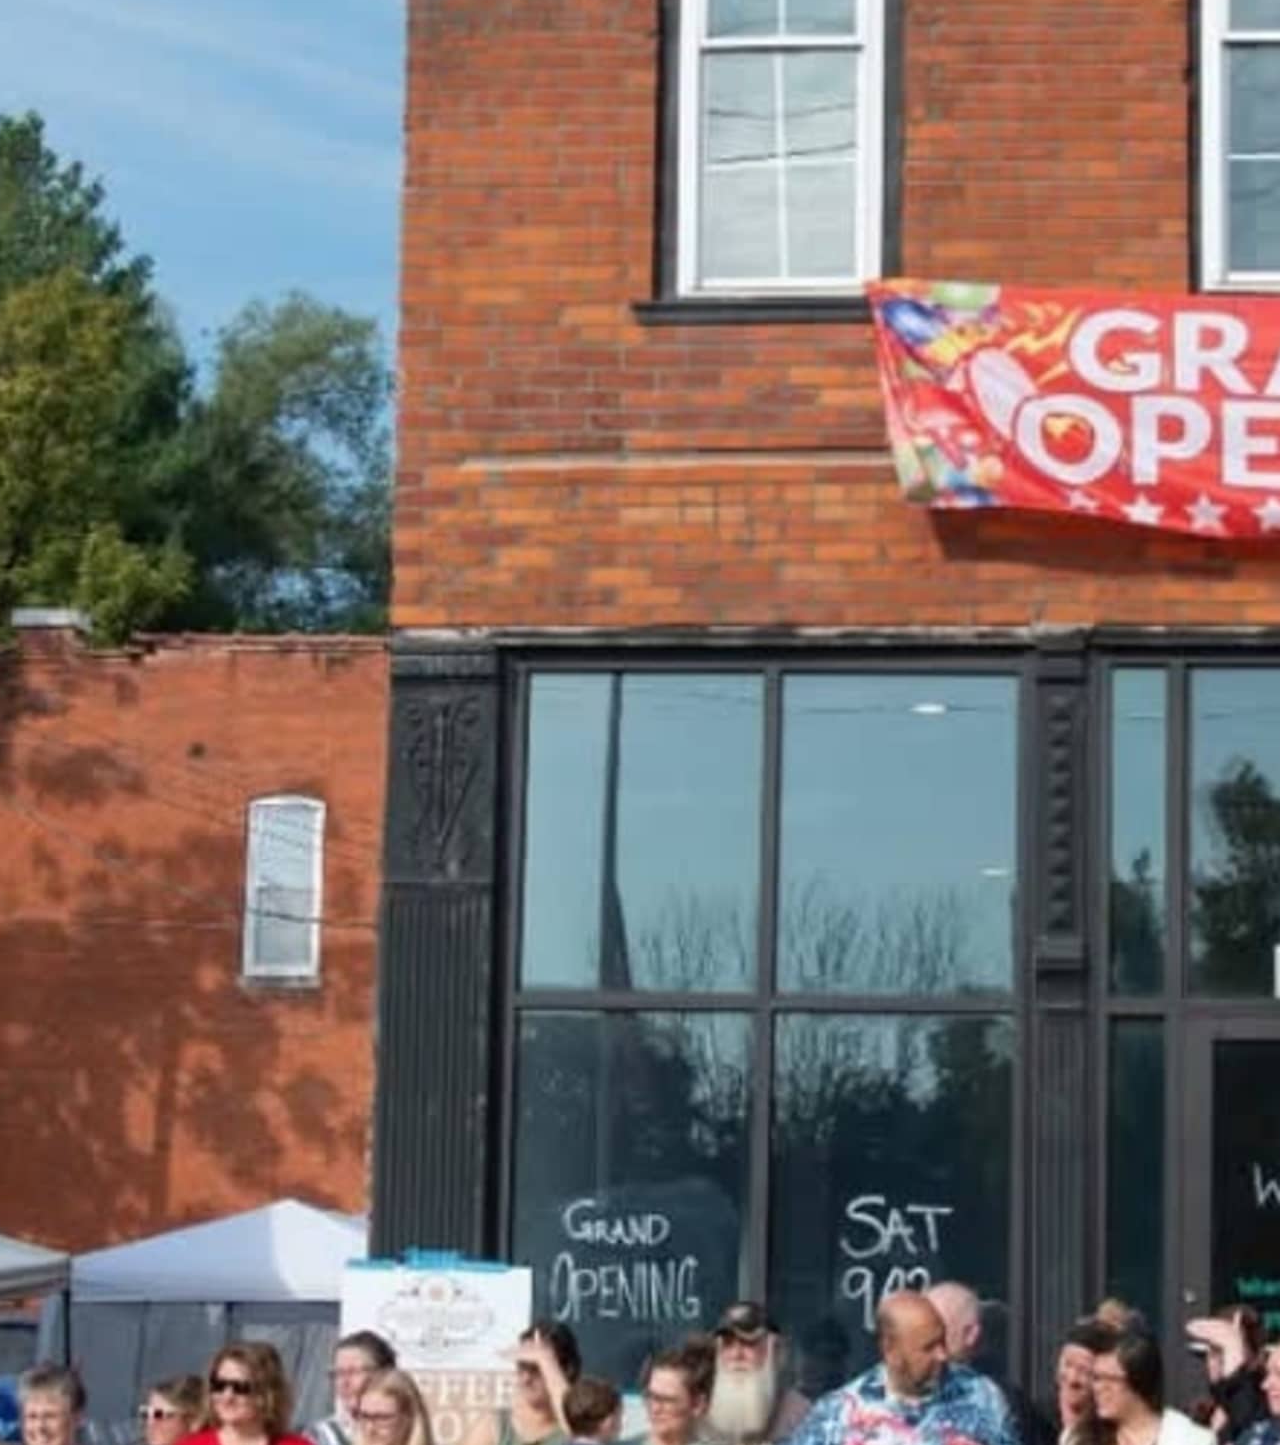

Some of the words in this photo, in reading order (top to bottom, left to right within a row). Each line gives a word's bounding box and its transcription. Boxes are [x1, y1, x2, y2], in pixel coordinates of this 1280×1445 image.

[561, 1198, 670, 1247] GRAND
[839, 1195, 954, 1258] SAT
[550, 1252, 700, 1321] OPENING
